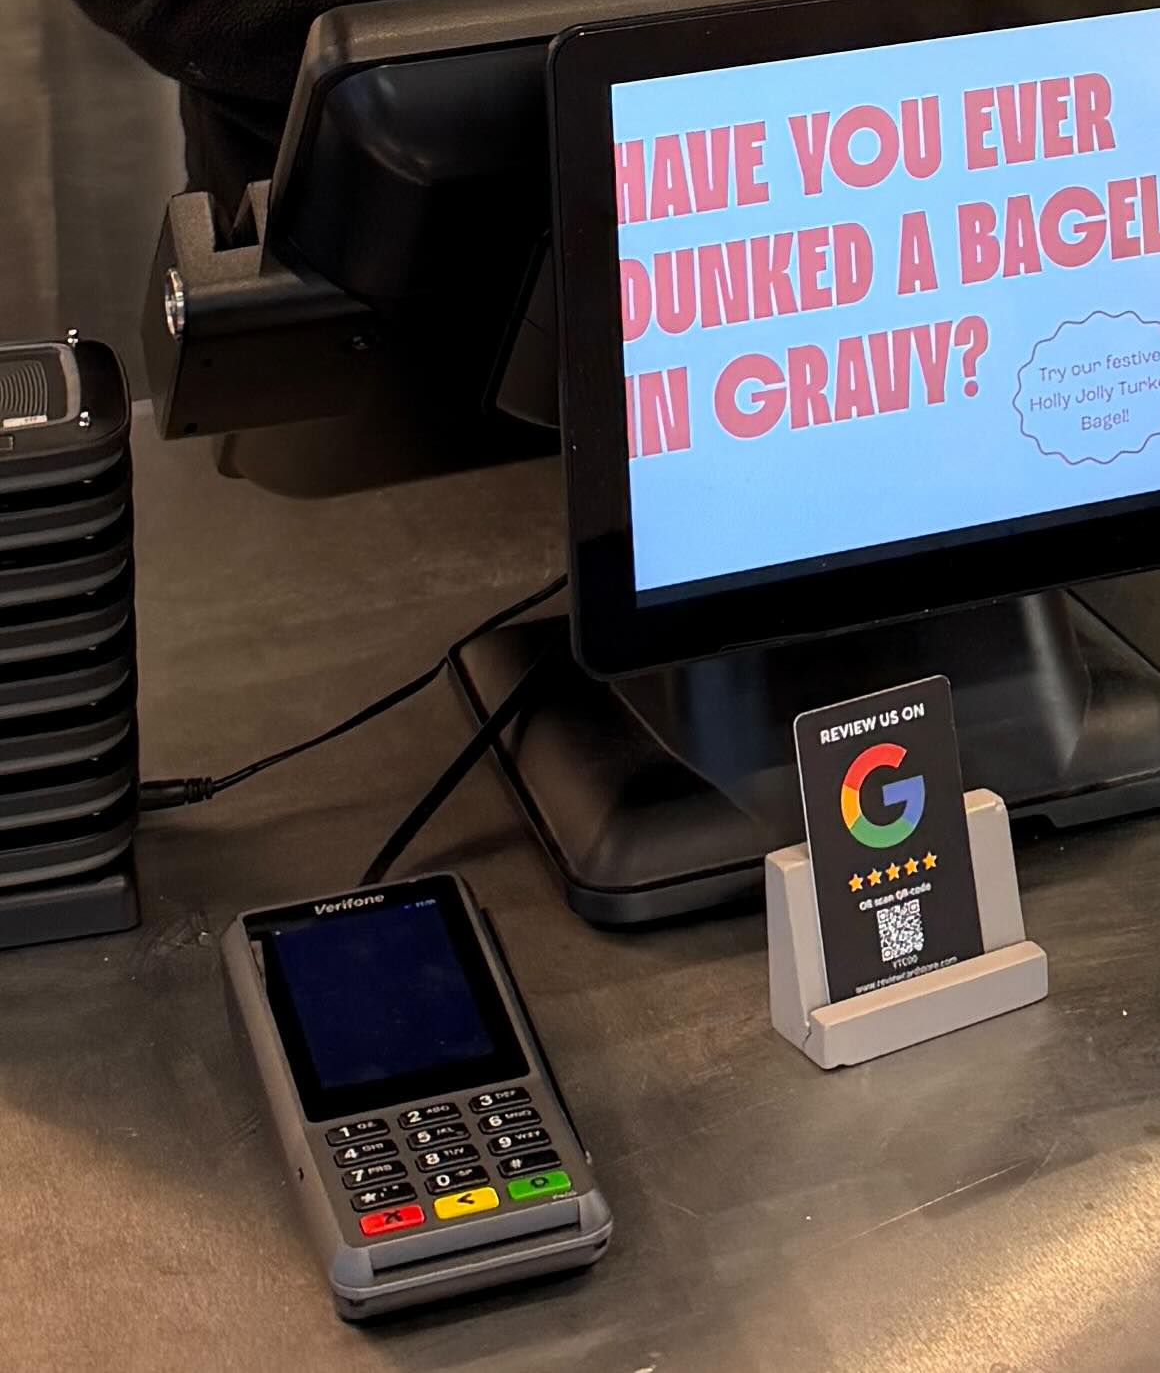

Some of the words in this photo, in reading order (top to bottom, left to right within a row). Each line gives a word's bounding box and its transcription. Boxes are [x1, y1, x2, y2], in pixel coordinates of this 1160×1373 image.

[614, 121, 770, 225] HAVE
[789, 95, 941, 196] YOU
[964, 73, 1116, 170] EVER
[619, 223, 874, 342] DUNKED
[898, 211, 938, 296] A
[1038, 367, 1066, 383] Try
[1072, 361, 1102, 376] our
[1106, 351, 1160, 369] festive
[714, 315, 991, 439] GRAVY?
[1030, 393, 1070, 412] Holly
[1076, 385, 1114, 403] Jolly
[1082, 409, 1129, 431] Bagel!
[820, 716, 876, 744] REVIEW
[879, 709, 899, 728] US
[901, 703, 925, 722] ON
[841, 742, 925, 849] G
[314, 894, 384, 915] Verifone
[479, 1095, 493, 1106] 3
[407, 1110, 422, 1123] 2
[488, 1115, 502, 1127] 6
[339, 1126, 350, 1138] 1
[416, 1131, 431, 1143] 5
[498, 1137, 512, 1148] 9
[344, 1148, 358, 1160] 4
[425, 1153, 440, 1165] 8
[351, 1169, 365, 1182] 7
[436, 1175, 450, 1186] 0
